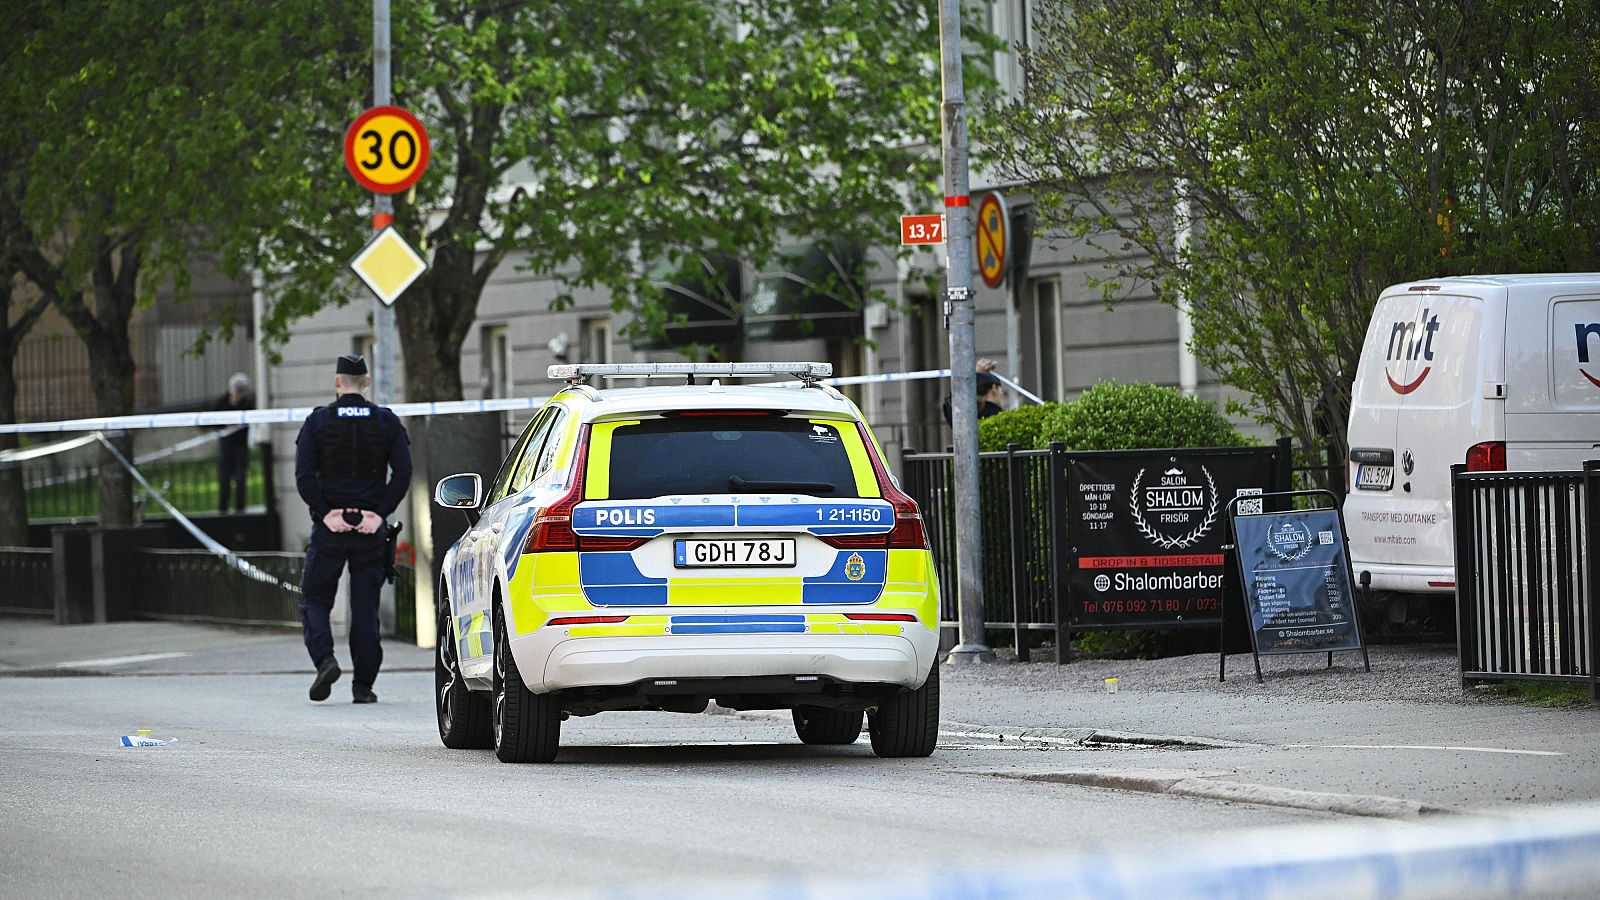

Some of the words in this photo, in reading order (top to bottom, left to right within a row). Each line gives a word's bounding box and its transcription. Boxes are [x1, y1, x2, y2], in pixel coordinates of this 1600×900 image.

[361, 130, 416, 170] 30
[909, 223, 940, 240] 13,7
[1386, 308, 1440, 361] mlt
[338, 407, 370, 417] POLIS
[1161, 476, 1187, 486] SALON
[1361, 467, 1374, 483] NSL
[1375, 467, 1391, 484] 59M
[1079, 483, 1115, 492] ÖPPETTIDER
[670, 496, 799, 504] VOLVO
[1146, 490, 1204, 507] SHALOM
[1089, 503, 1107, 511] 10-19
[596, 508, 655, 525] POLIS
[815, 508, 823, 521] 1
[829, 508, 881, 522] 21-1150
[1082, 512, 1114, 520] SÖNDAGAR
[1161, 512, 1189, 523] FRISÖR
[1361, 512, 1389, 522] TRANSPORT
[1390, 512, 1402, 523] MED
[1404, 513, 1436, 524] OMTANKE
[1089, 522, 1108, 530] 11-17
[1274, 532, 1304, 542] SHALOM
[694, 543, 736, 562] GDH
[743, 543, 785, 562] 78J
[1092, 559, 1123, 568] DROP
[1126, 558, 1136, 567] IN
[1103, 601, 1123, 613] 076
[1127, 600, 1146, 612] 092
[1151, 600, 1163, 611] 71
[1166, 600, 1180, 611] 80
